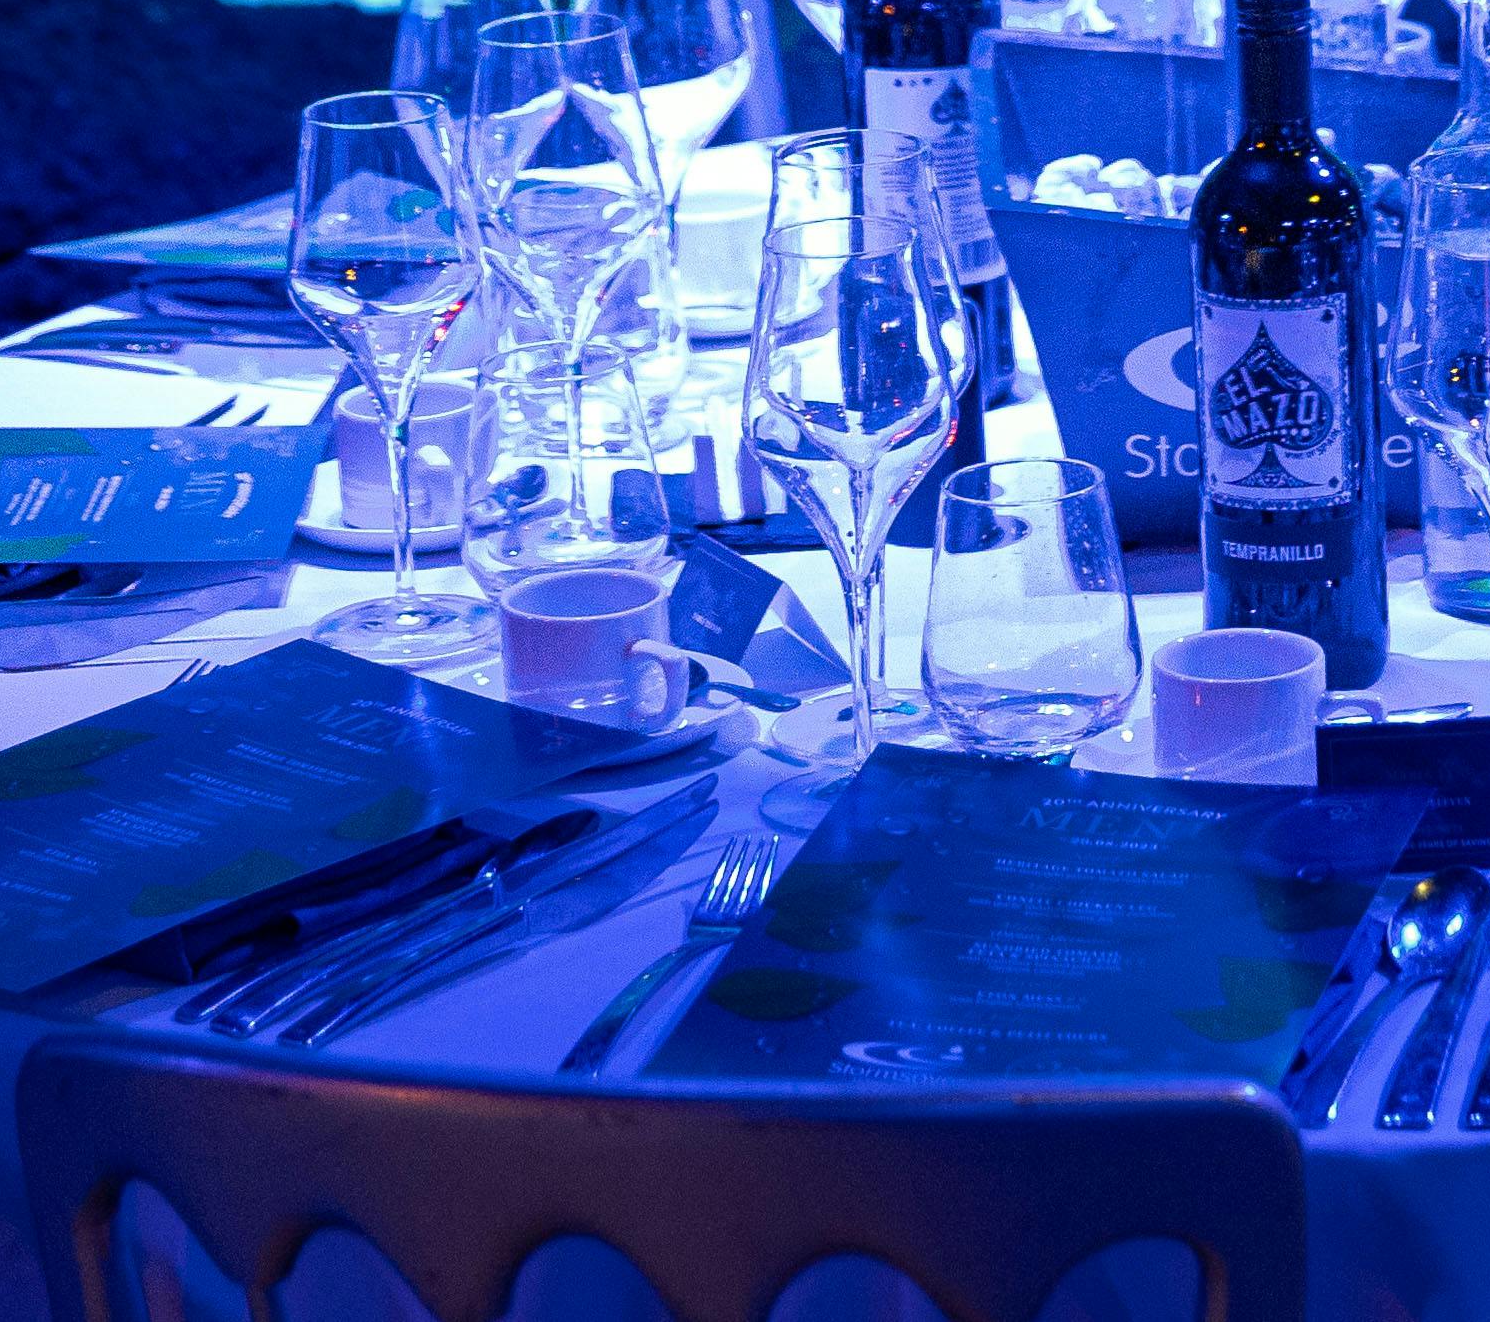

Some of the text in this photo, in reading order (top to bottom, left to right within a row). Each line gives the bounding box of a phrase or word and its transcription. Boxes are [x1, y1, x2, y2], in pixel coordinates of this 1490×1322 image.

[1225, 366, 1272, 407] EL
[1221, 390, 1320, 441] MAZO
[1221, 539, 1325, 563] TEMPRANILLO
[1086, 799, 1228, 821] ANNIVERSARY
